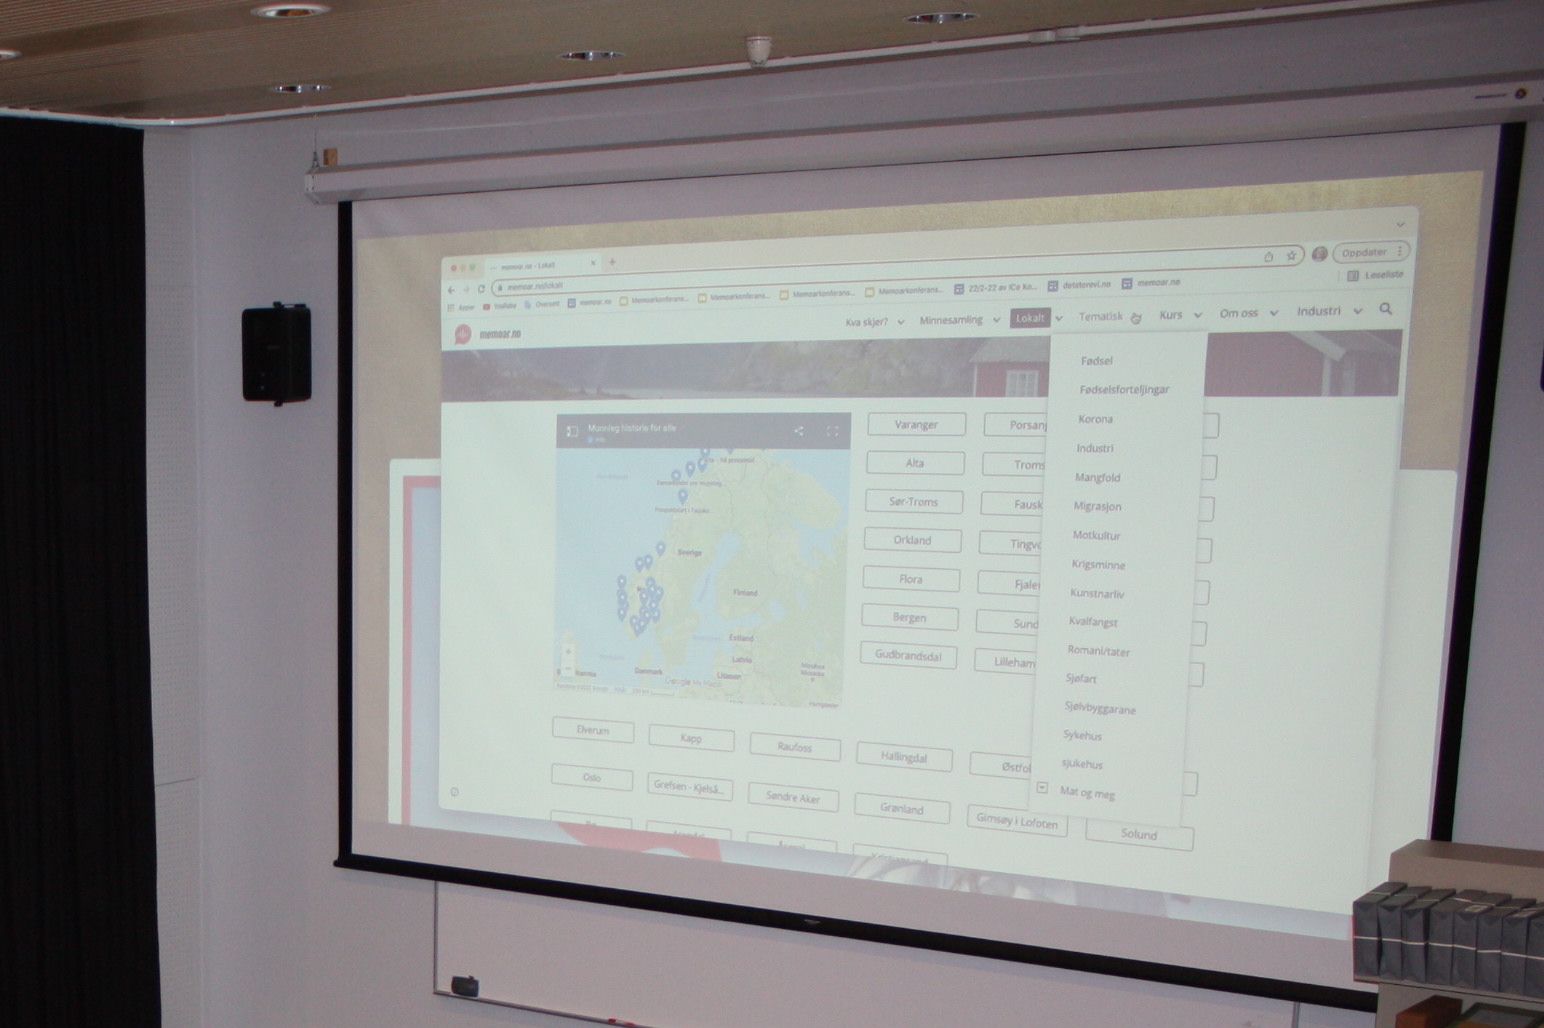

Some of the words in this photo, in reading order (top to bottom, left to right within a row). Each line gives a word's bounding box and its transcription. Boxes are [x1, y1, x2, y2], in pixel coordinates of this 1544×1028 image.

[1342, 247, 1387, 259] Oppdater
[1365, 270, 1404, 280] Leseliste
[1137, 279, 1181, 287] memoar.no
[1016, 312, 1046, 323] Lokalt
[1079, 311, 1124, 322] Tematisk
[1160, 310, 1183, 320] Kurs
[1220, 308, 1239, 318] Om
[1240, 309, 1258, 318] oss
[1297, 306, 1341, 317] Industri
[845, 318, 861, 328] Kva
[863, 316, 888, 328] skjer?
[920, 314, 983, 326] Minnesamling
[479, 328, 522, 340] memoar.no
[1081, 355, 1114, 366] Fødsel
[1079, 384, 1170, 397] Fødselsforteljingar
[1078, 414, 1114, 424] Korona
[895, 419, 939, 432] Varanger
[1076, 443, 1114, 453] Industri
[905, 458, 925, 469] Alta
[1074, 472, 1121, 485] Mangfold
[889, 496, 939, 507] Sør-Troms
[1073, 500, 1122, 514] Migrasjon
[893, 535, 932, 546] Orkland
[1072, 530, 1121, 541] Motkultur
[1071, 559, 1126, 572] Krigsminne
[899, 574, 923, 585] Flora
[1070, 588, 1125, 600] Kunstnarliv
[892, 611, 927, 624] Bergen
[1068, 616, 1119, 630] Kvalfangst
[875, 648, 943, 663] Gudbrandsdal
[1067, 644, 1131, 658] Romani/tater
[1065, 672, 1097, 685] Sjøfart
[1064, 700, 1137, 716] Sjølvbyggarane
[577, 724, 610, 735] Elverum
[1063, 729, 1103, 742] Sykehus
[680, 733, 703, 745] Kapp
[777, 741, 813, 753] Raufoss
[881, 751, 927, 764] Hallingdal
[1061, 759, 1104, 771] sjukehus
[583, 773, 601, 783] Oslo
[654, 779, 687, 791] Grefsen
[766, 790, 798, 802] Søndre
[799, 794, 821, 805] Aker
[1060, 786, 1079, 797] Mat
[1080, 789, 1093, 801] og
[1094, 790, 1116, 802] meg
[880, 802, 924, 815] Grønland
[976, 813, 1012, 827] Gimsøy
[1020, 817, 1058, 830] Lofoten
[1121, 828, 1158, 841] Solund
